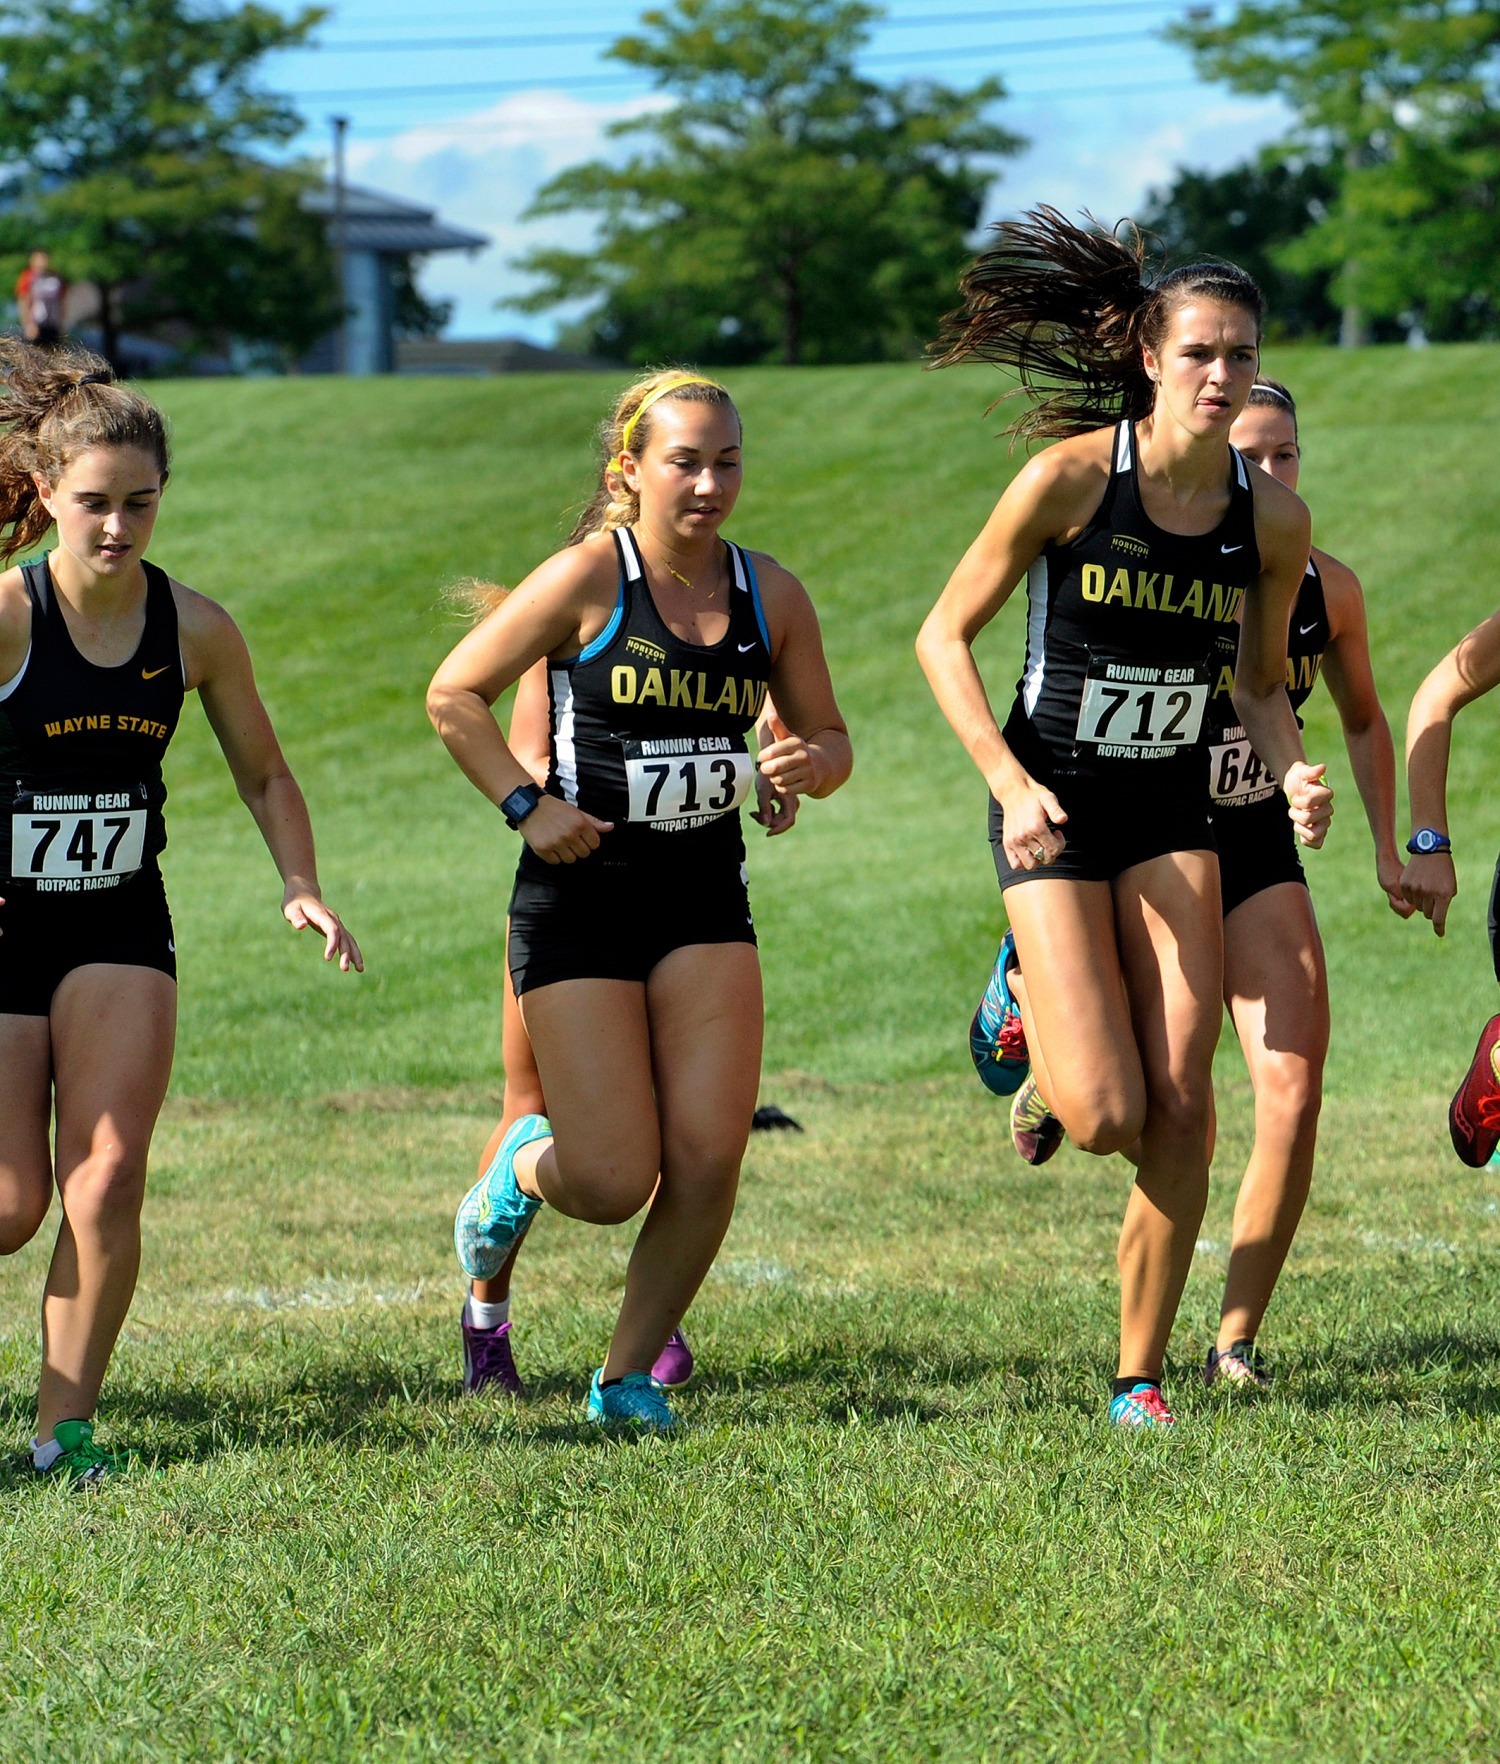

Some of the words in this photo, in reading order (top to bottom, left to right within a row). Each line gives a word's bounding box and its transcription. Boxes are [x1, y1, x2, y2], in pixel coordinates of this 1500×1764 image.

[1112, 538, 1149, 555] HORIZON
[1081, 563, 1243, 623] OAKLAND
[627, 639, 666, 660] HORIZON
[1106, 664, 1161, 682] RUNNIN'
[1164, 668, 1195, 683] GEAR
[1094, 687, 1192, 741] 712
[45, 715, 111, 737] WAYNE
[117, 716, 168, 739] STATE
[641, 739, 695, 756] RUNNIN'
[699, 737, 731, 752] GEAR
[1097, 744, 1138, 759] ROTPAC
[1141, 746, 1177, 759] RACING
[643, 759, 736, 816] 713
[33, 795, 92, 810] RUNNIN'
[95, 793, 130, 810] GEAR
[30, 817, 131, 873] 747
[36, 879, 81, 892] ROTPAC
[83, 875, 120, 891] RACING
